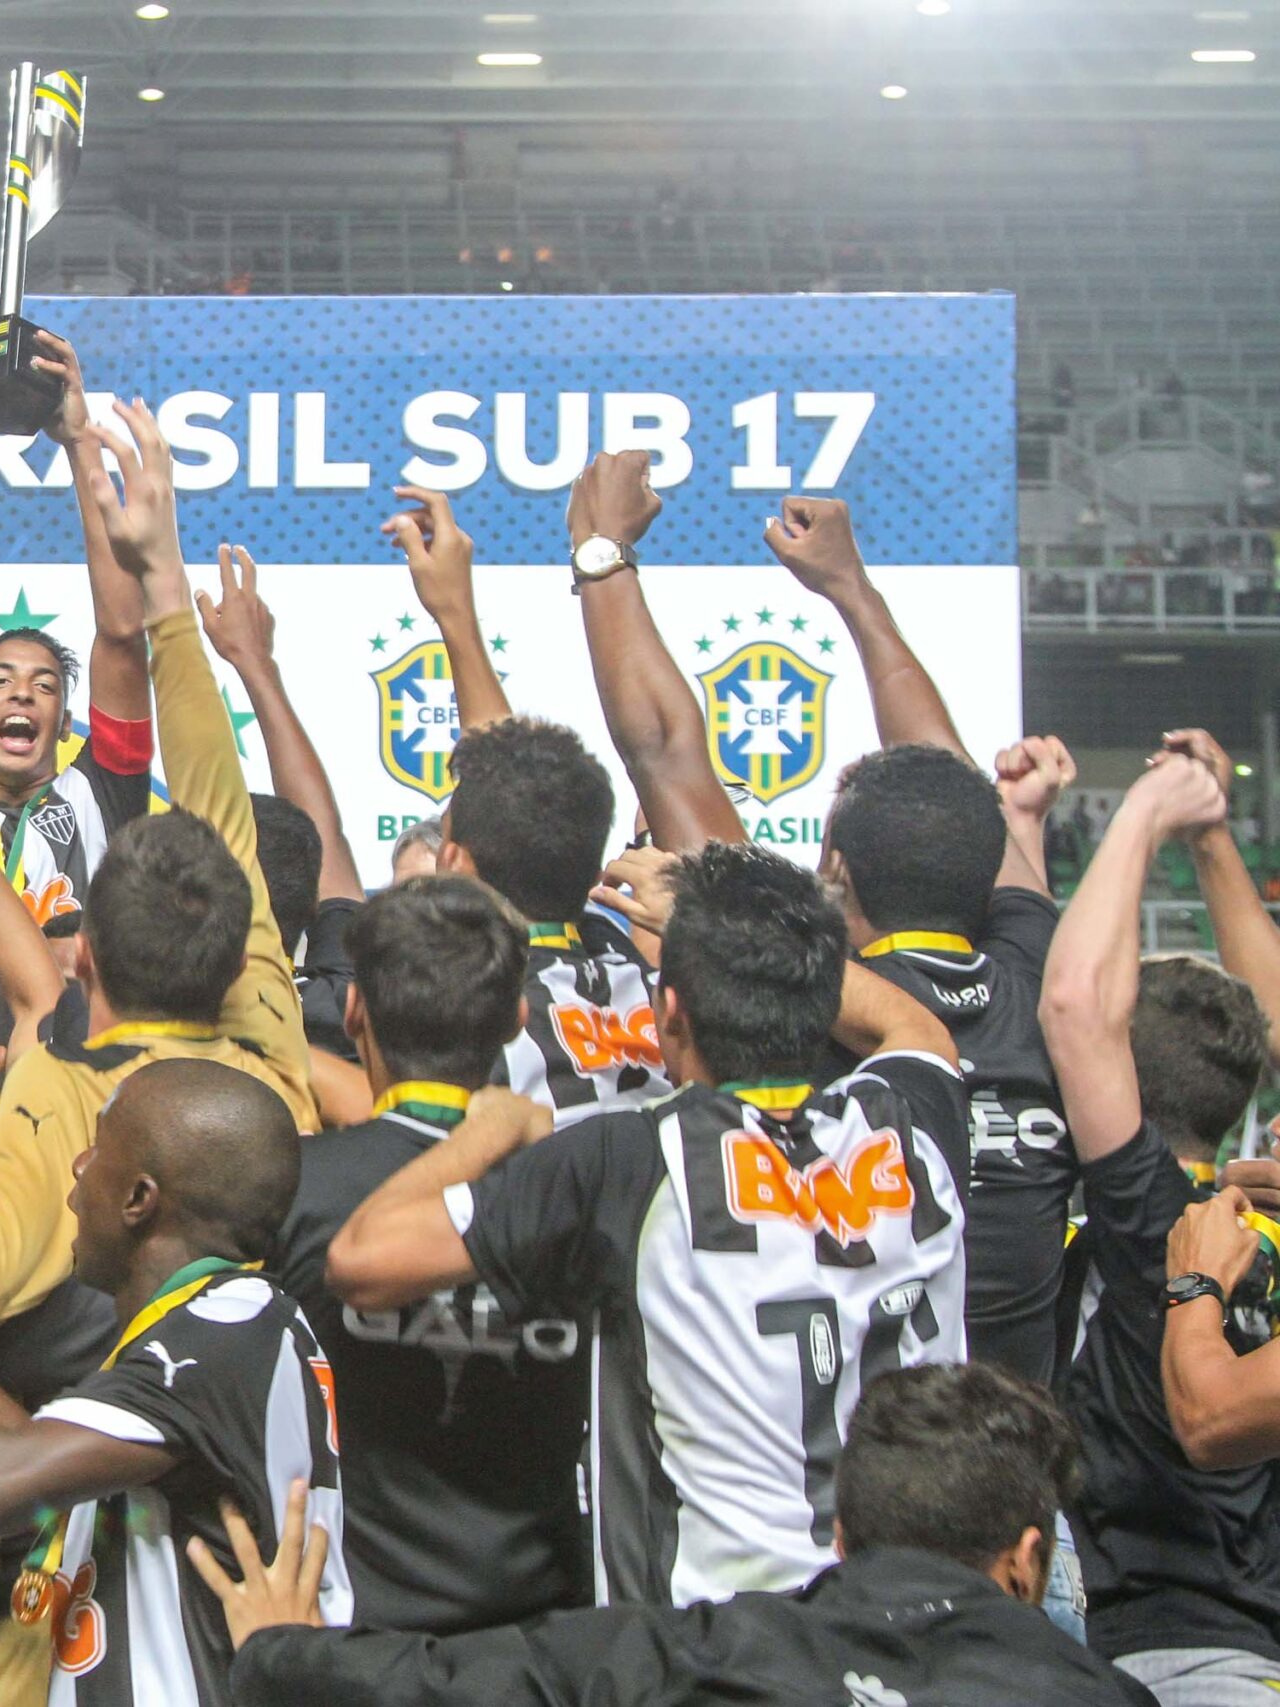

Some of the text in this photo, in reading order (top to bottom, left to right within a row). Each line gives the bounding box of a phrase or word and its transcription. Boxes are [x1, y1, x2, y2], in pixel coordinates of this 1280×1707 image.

[400, 390, 694, 490] SUB
[731, 391, 876, 490] 17
[417, 707, 460, 724] CBF
[744, 708, 788, 726] CBF
[35, 807, 68, 824] CAM
[548, 1002, 667, 1079] BMG
[721, 1126, 916, 1249] BMG
